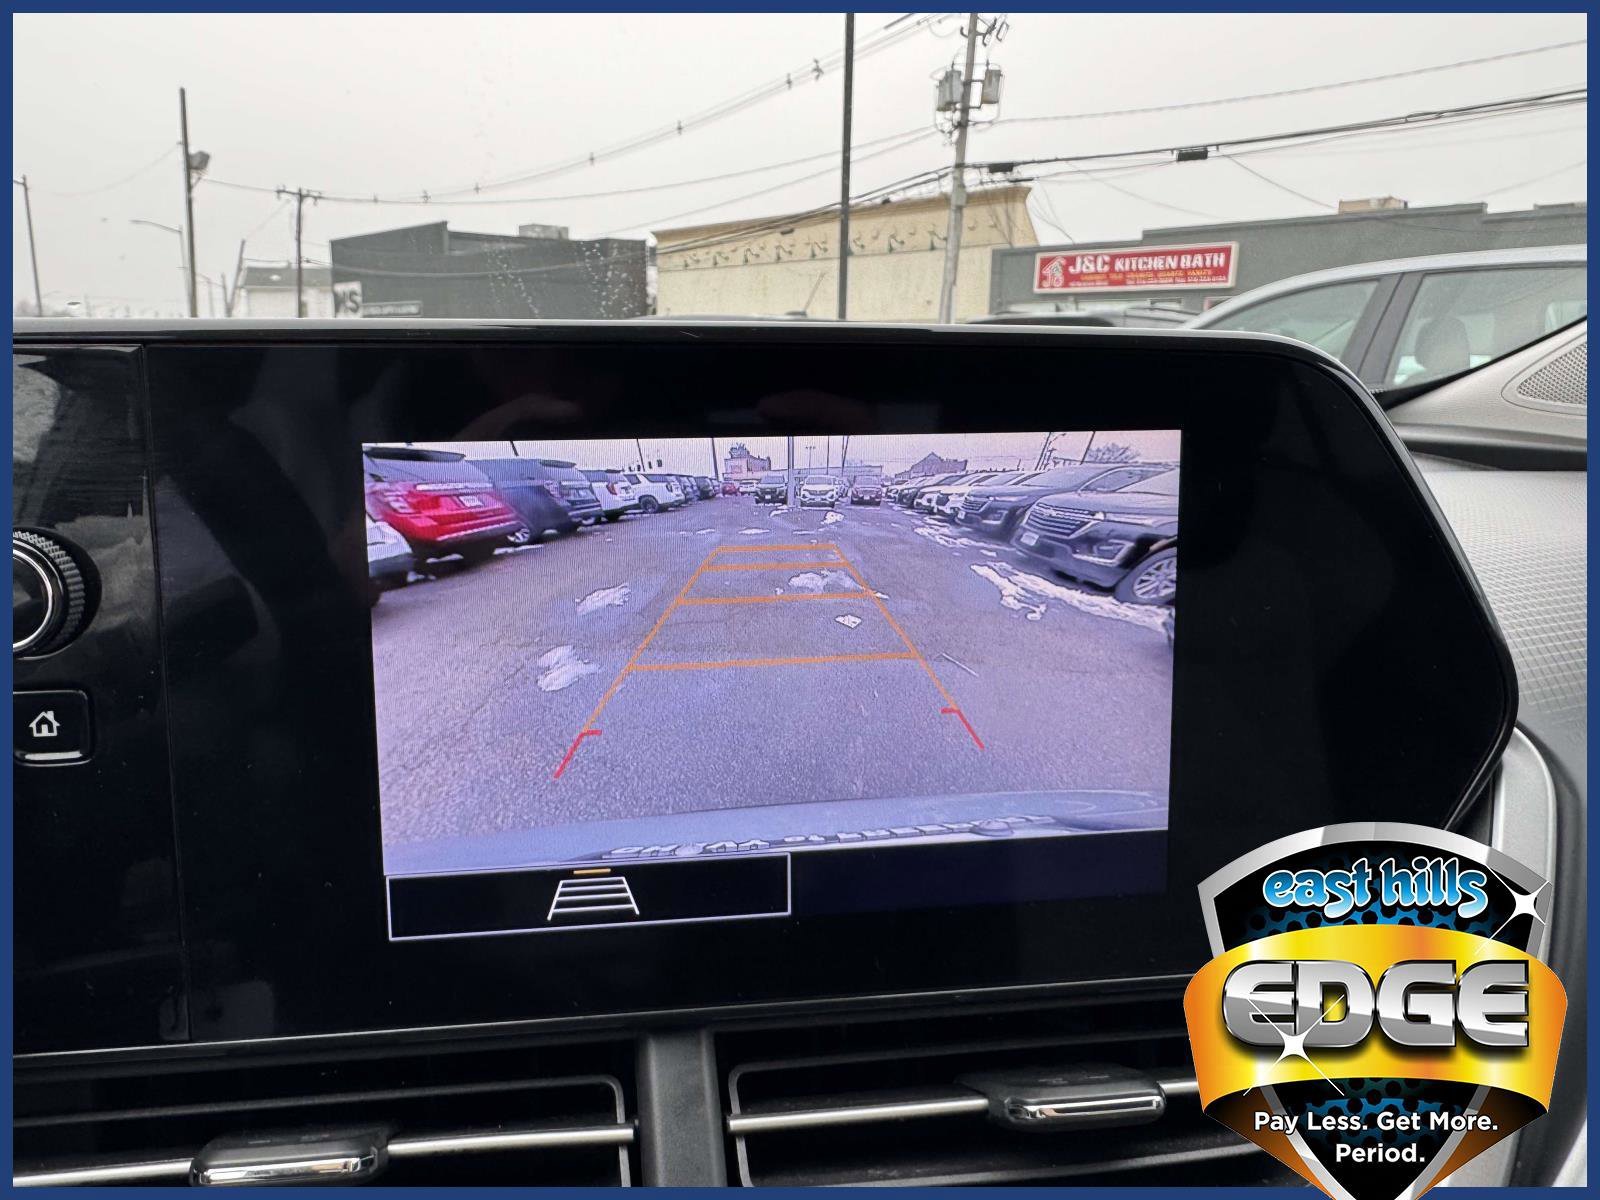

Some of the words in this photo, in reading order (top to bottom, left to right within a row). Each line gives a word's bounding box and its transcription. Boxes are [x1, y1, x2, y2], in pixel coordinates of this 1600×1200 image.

[1068, 254, 1110, 274] J&C
[1114, 254, 1179, 272] KITCHEN
[1180, 252, 1226, 269] BATH
